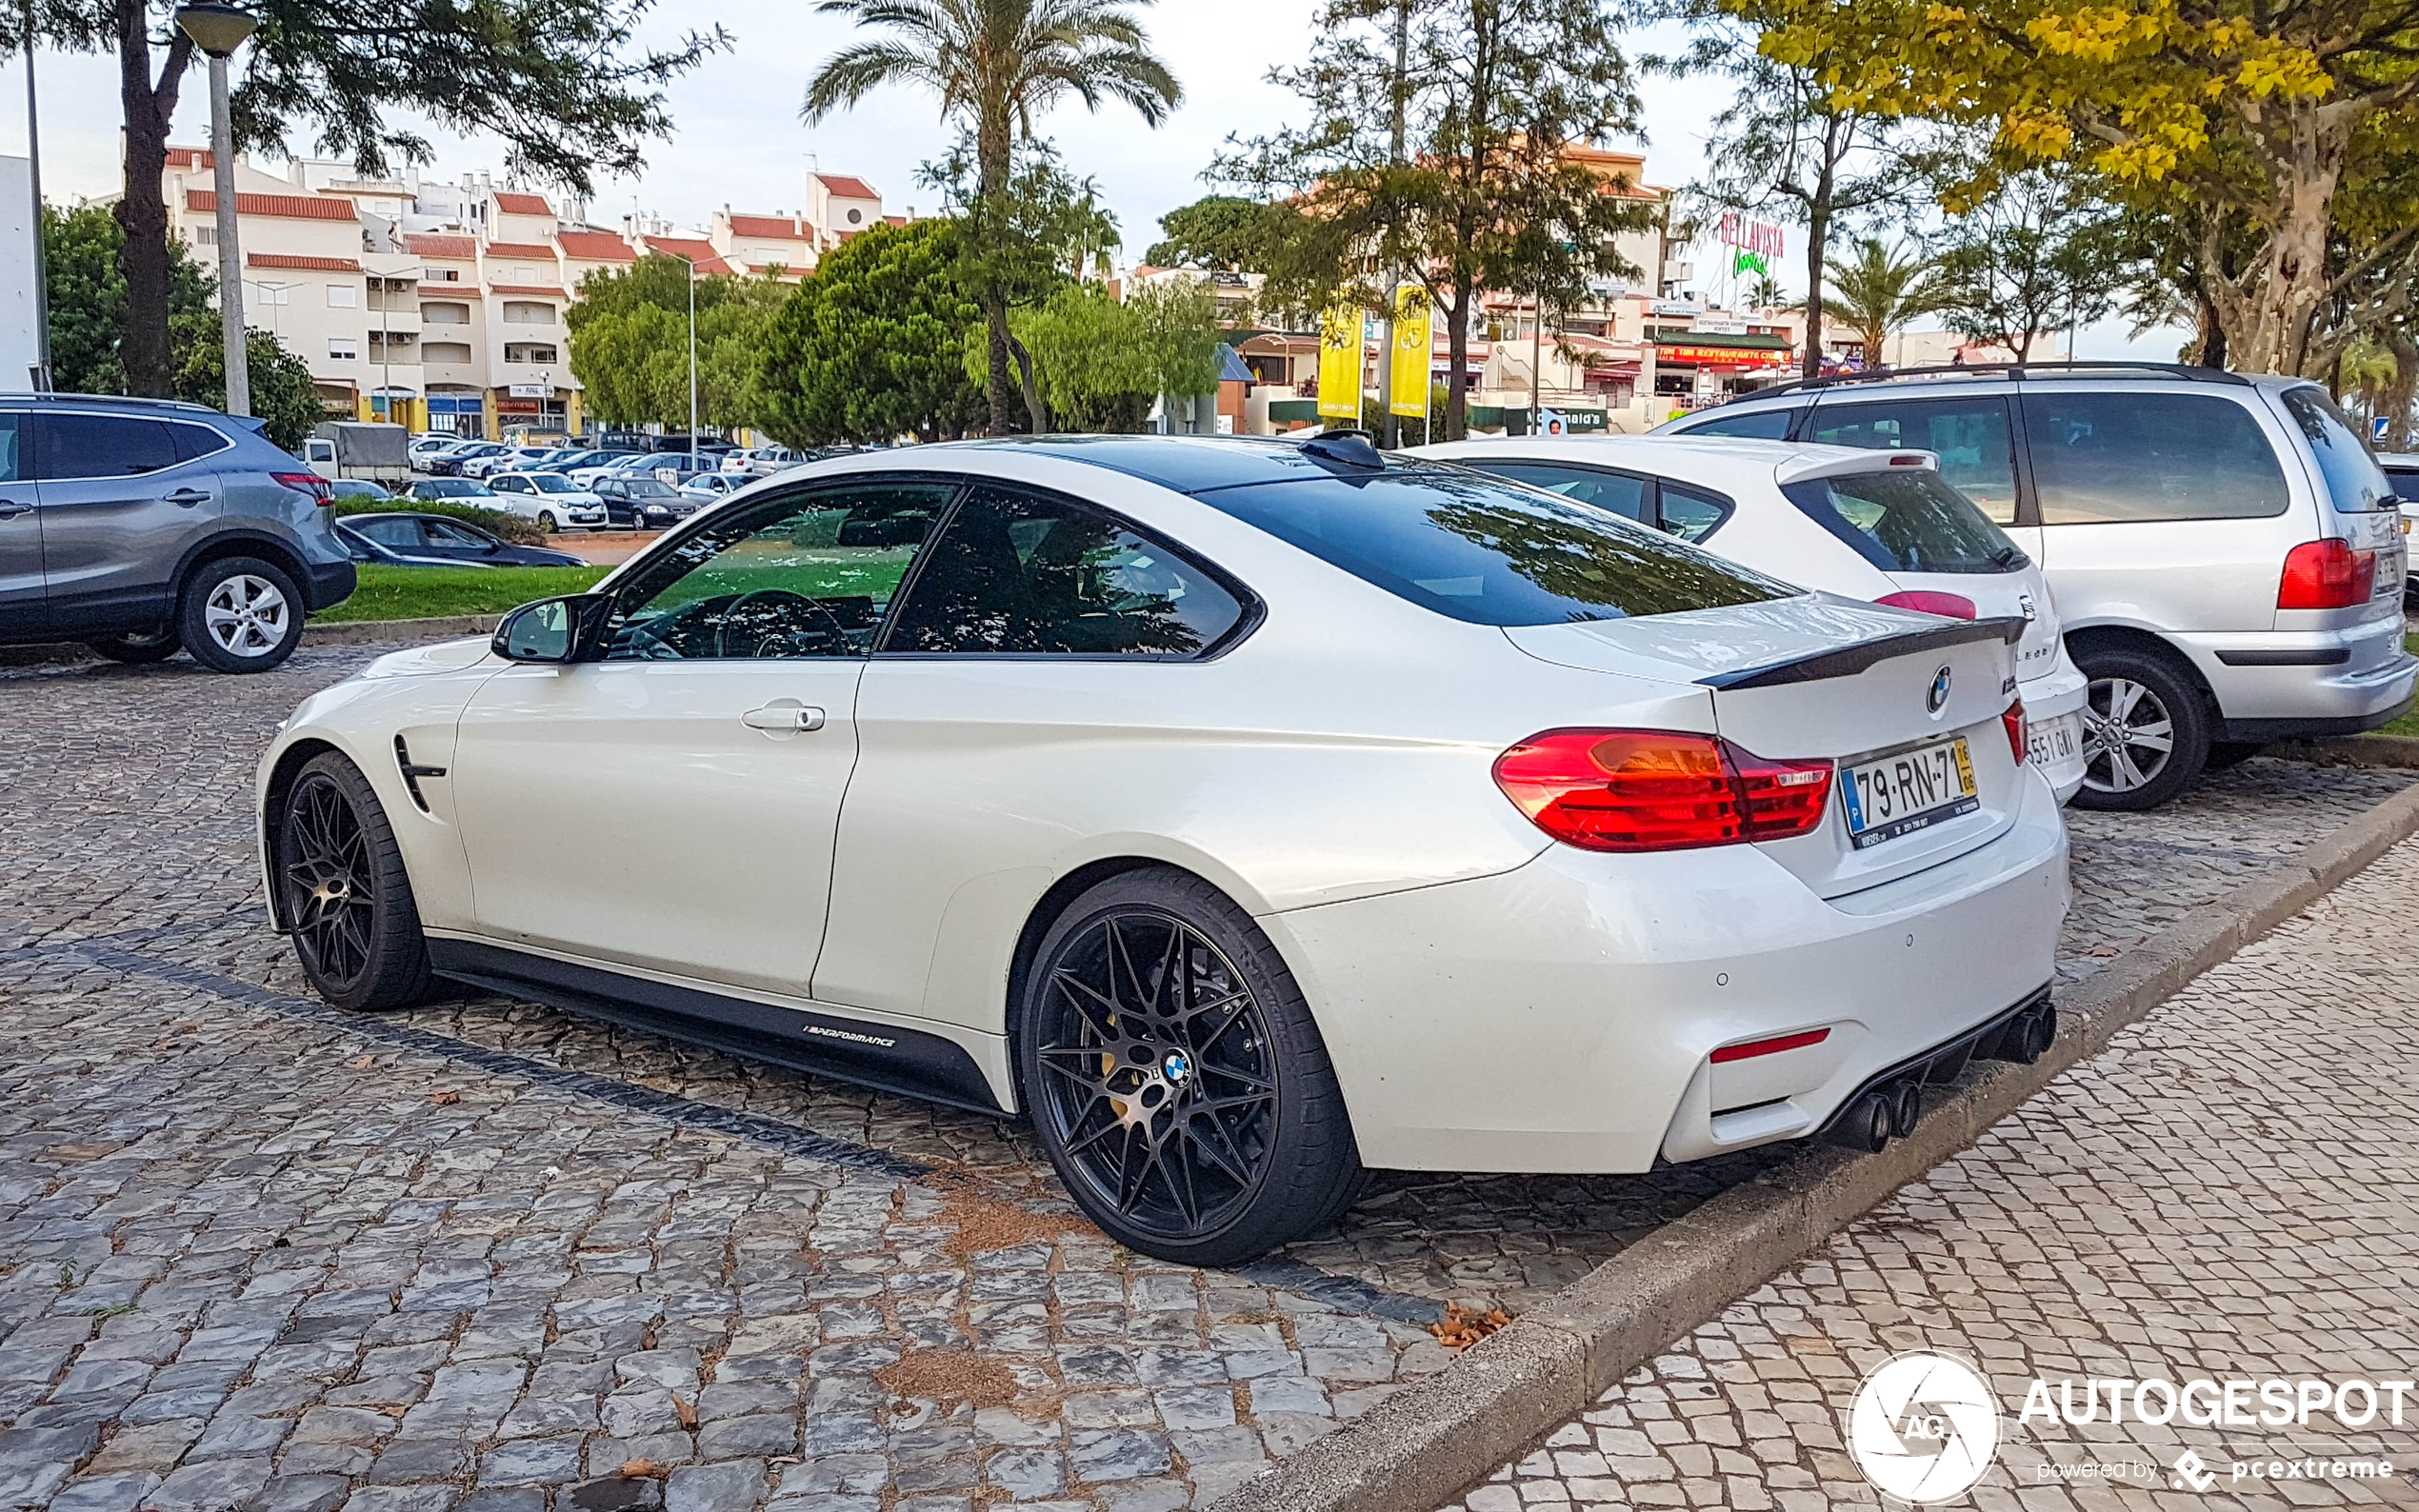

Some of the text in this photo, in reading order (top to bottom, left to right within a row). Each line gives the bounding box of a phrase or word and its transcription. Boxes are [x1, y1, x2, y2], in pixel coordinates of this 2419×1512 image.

[1721, 211, 1784, 259] BELLAVISTA
[1697, 348, 1759, 360] RESTAURANTE
[1851, 807, 1860, 822] P
